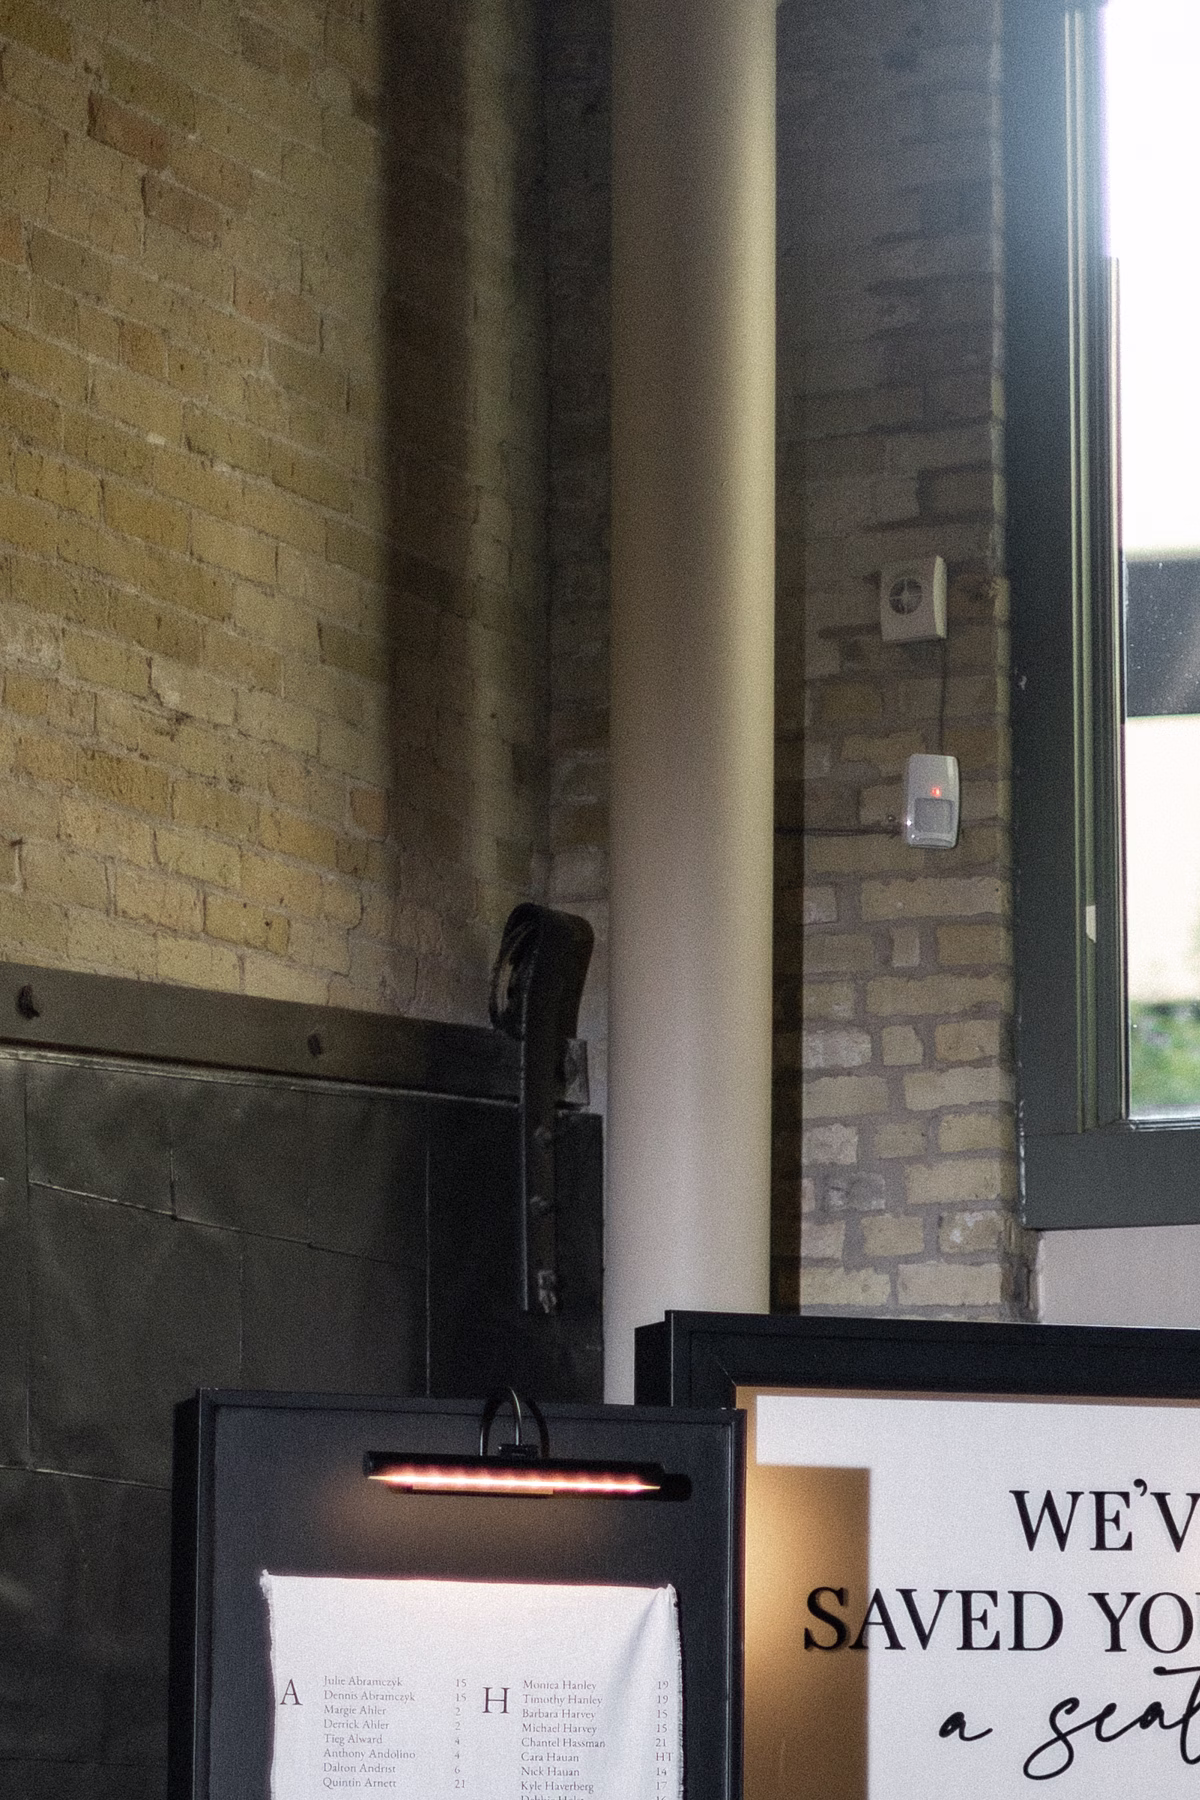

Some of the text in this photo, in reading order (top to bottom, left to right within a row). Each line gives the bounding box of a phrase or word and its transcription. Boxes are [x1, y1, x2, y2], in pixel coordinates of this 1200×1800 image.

[804, 1586, 1064, 1652] SAVED
[324, 1676, 466, 1691] Julie Abramczyk 15
[280, 1679, 302, 1706] A
[483, 1687, 510, 1714] H
[523, 1695, 668, 1707] Timothy Hanley 19
[522, 1710, 668, 1721] Barbara Harvey 15
[939, 1711, 993, 1742] a
[522, 1738, 666, 1748] Chantel Hassman 21
[324, 1749, 365, 1760] Anthony
[369, 1750, 416, 1759] Andolino
[323, 1778, 465, 1789] Quintin Arnett 21
[521, 1782, 667, 1794] Kyle Haverberg 17
